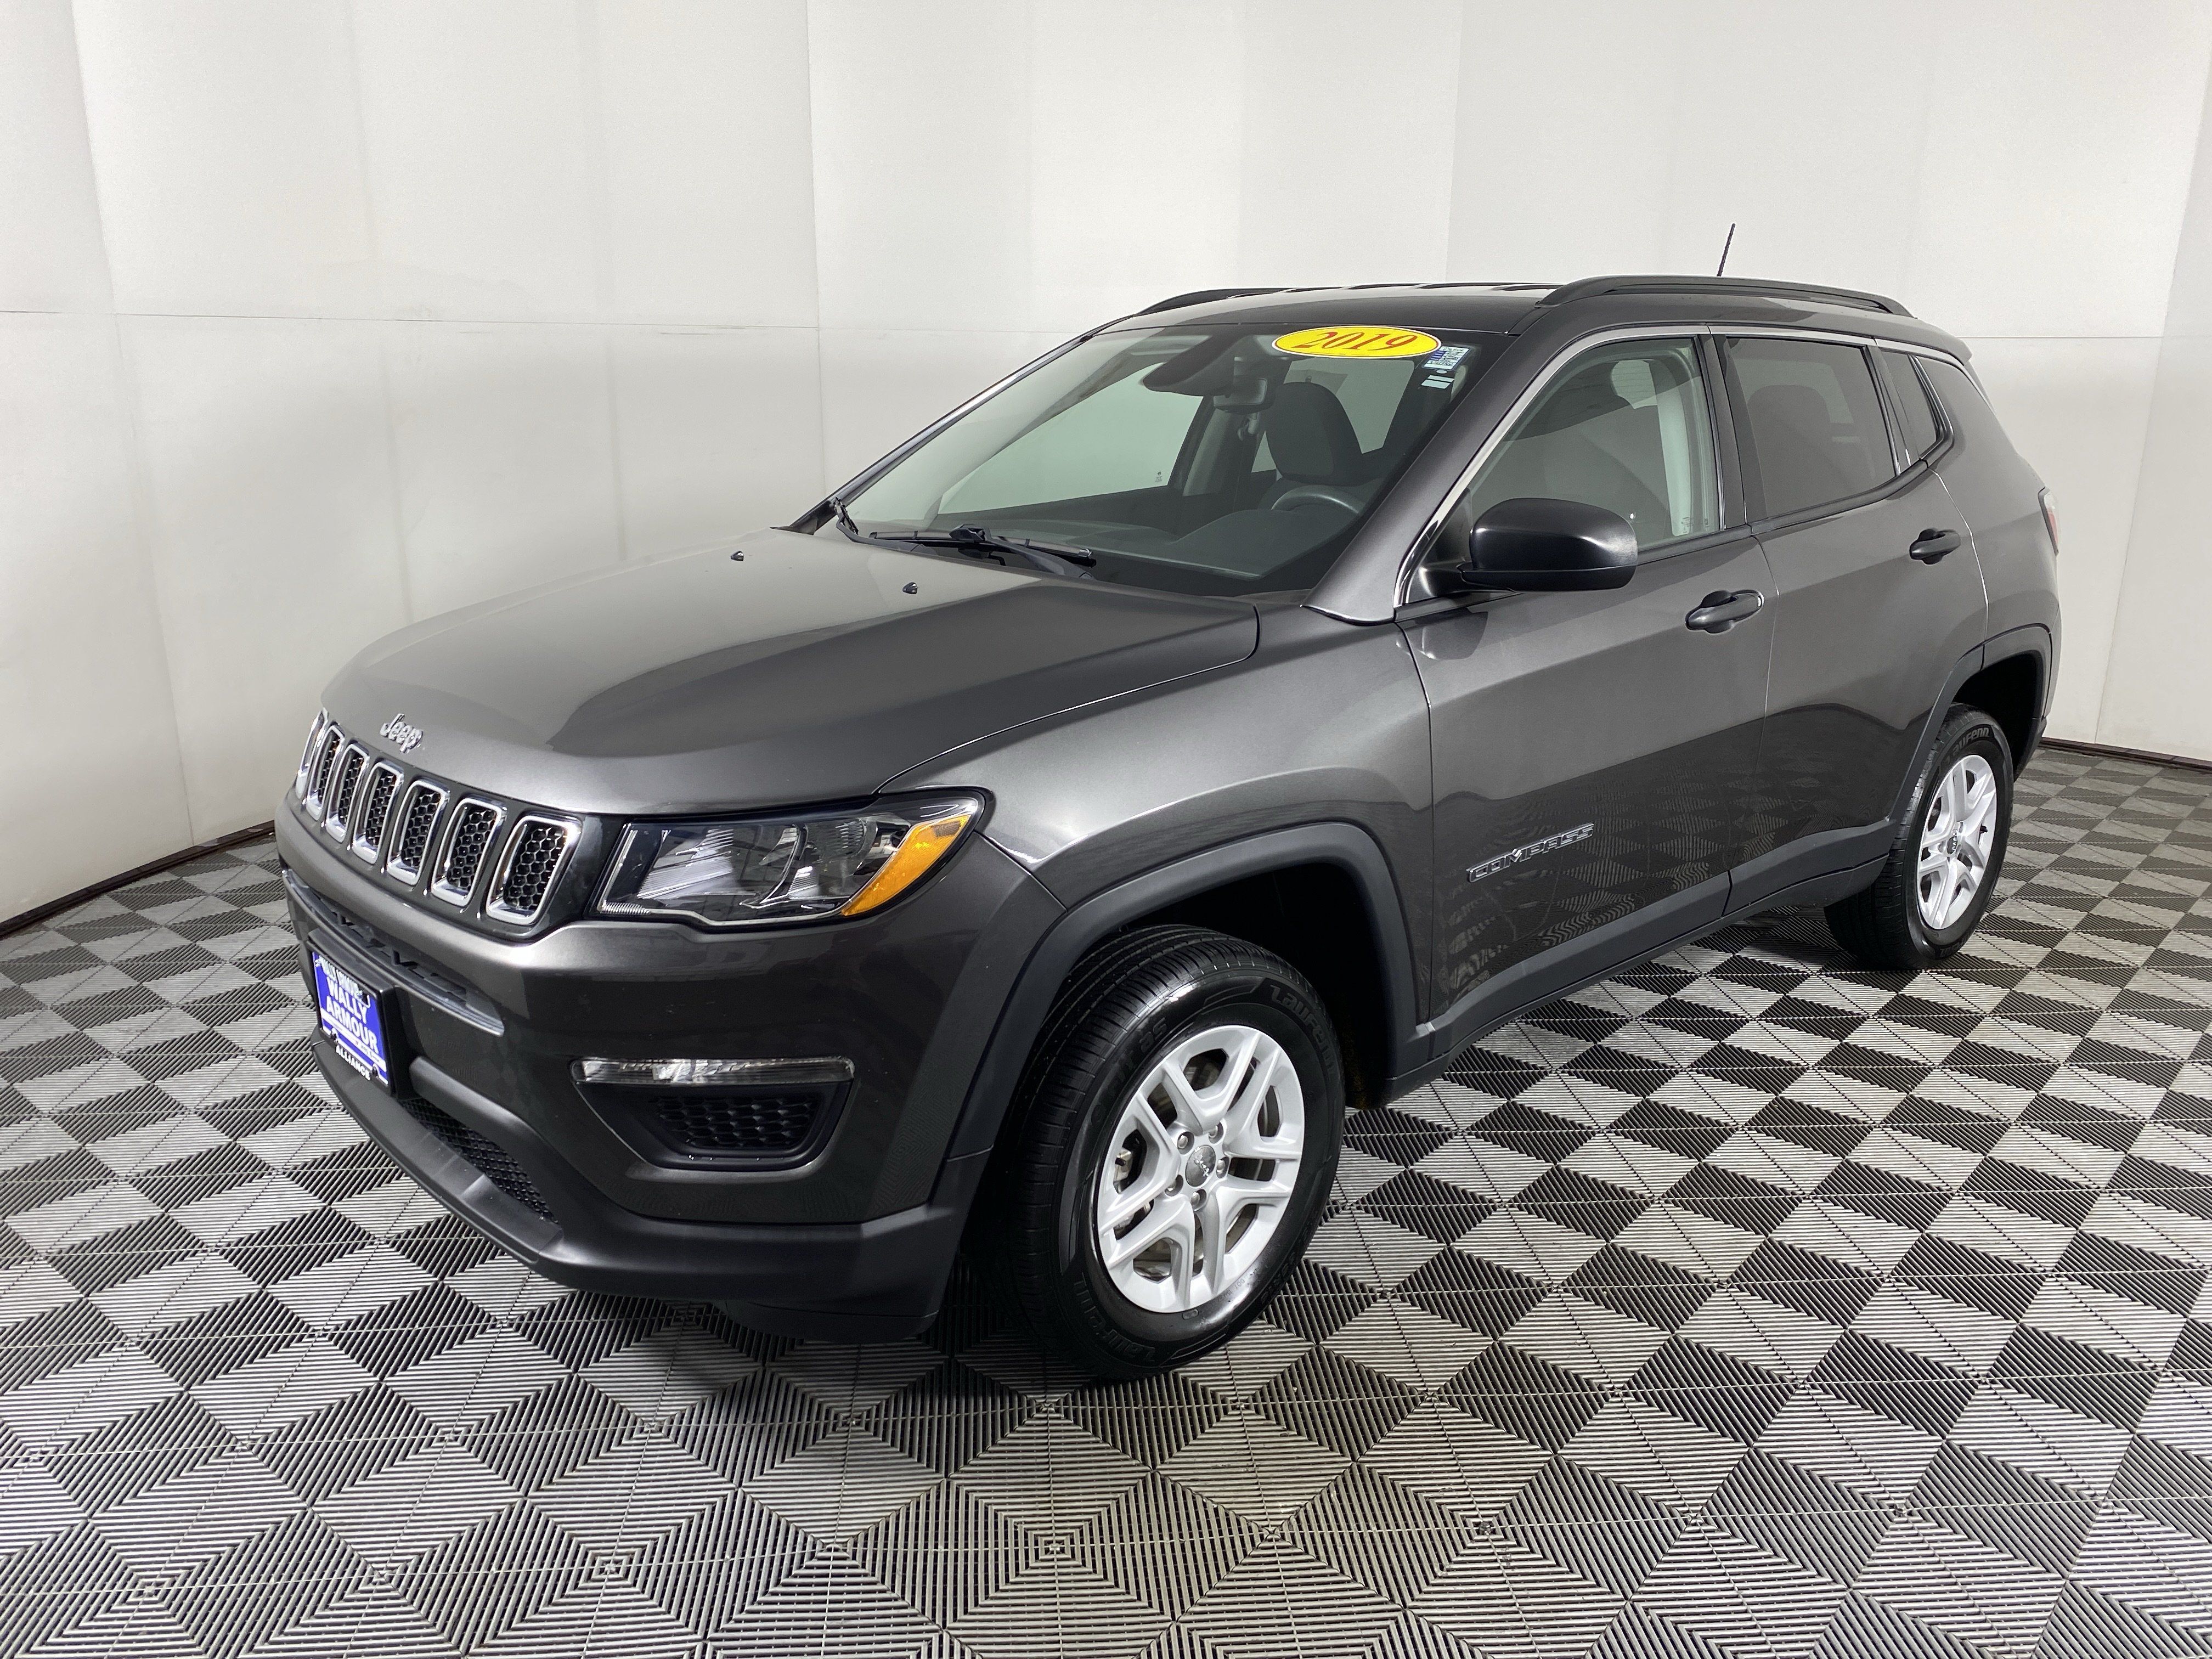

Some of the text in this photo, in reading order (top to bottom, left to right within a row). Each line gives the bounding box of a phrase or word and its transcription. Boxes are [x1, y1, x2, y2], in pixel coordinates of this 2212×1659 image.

[1292, 331, 1418, 351] 2019
[380, 713, 423, 753] Jeep
[1466, 823, 1594, 883] COMPASS
[326, 977, 367, 1024] WALLY
[326, 996, 379, 1054] ARMOUR
[336, 1045, 371, 1081] ALLIANCE
